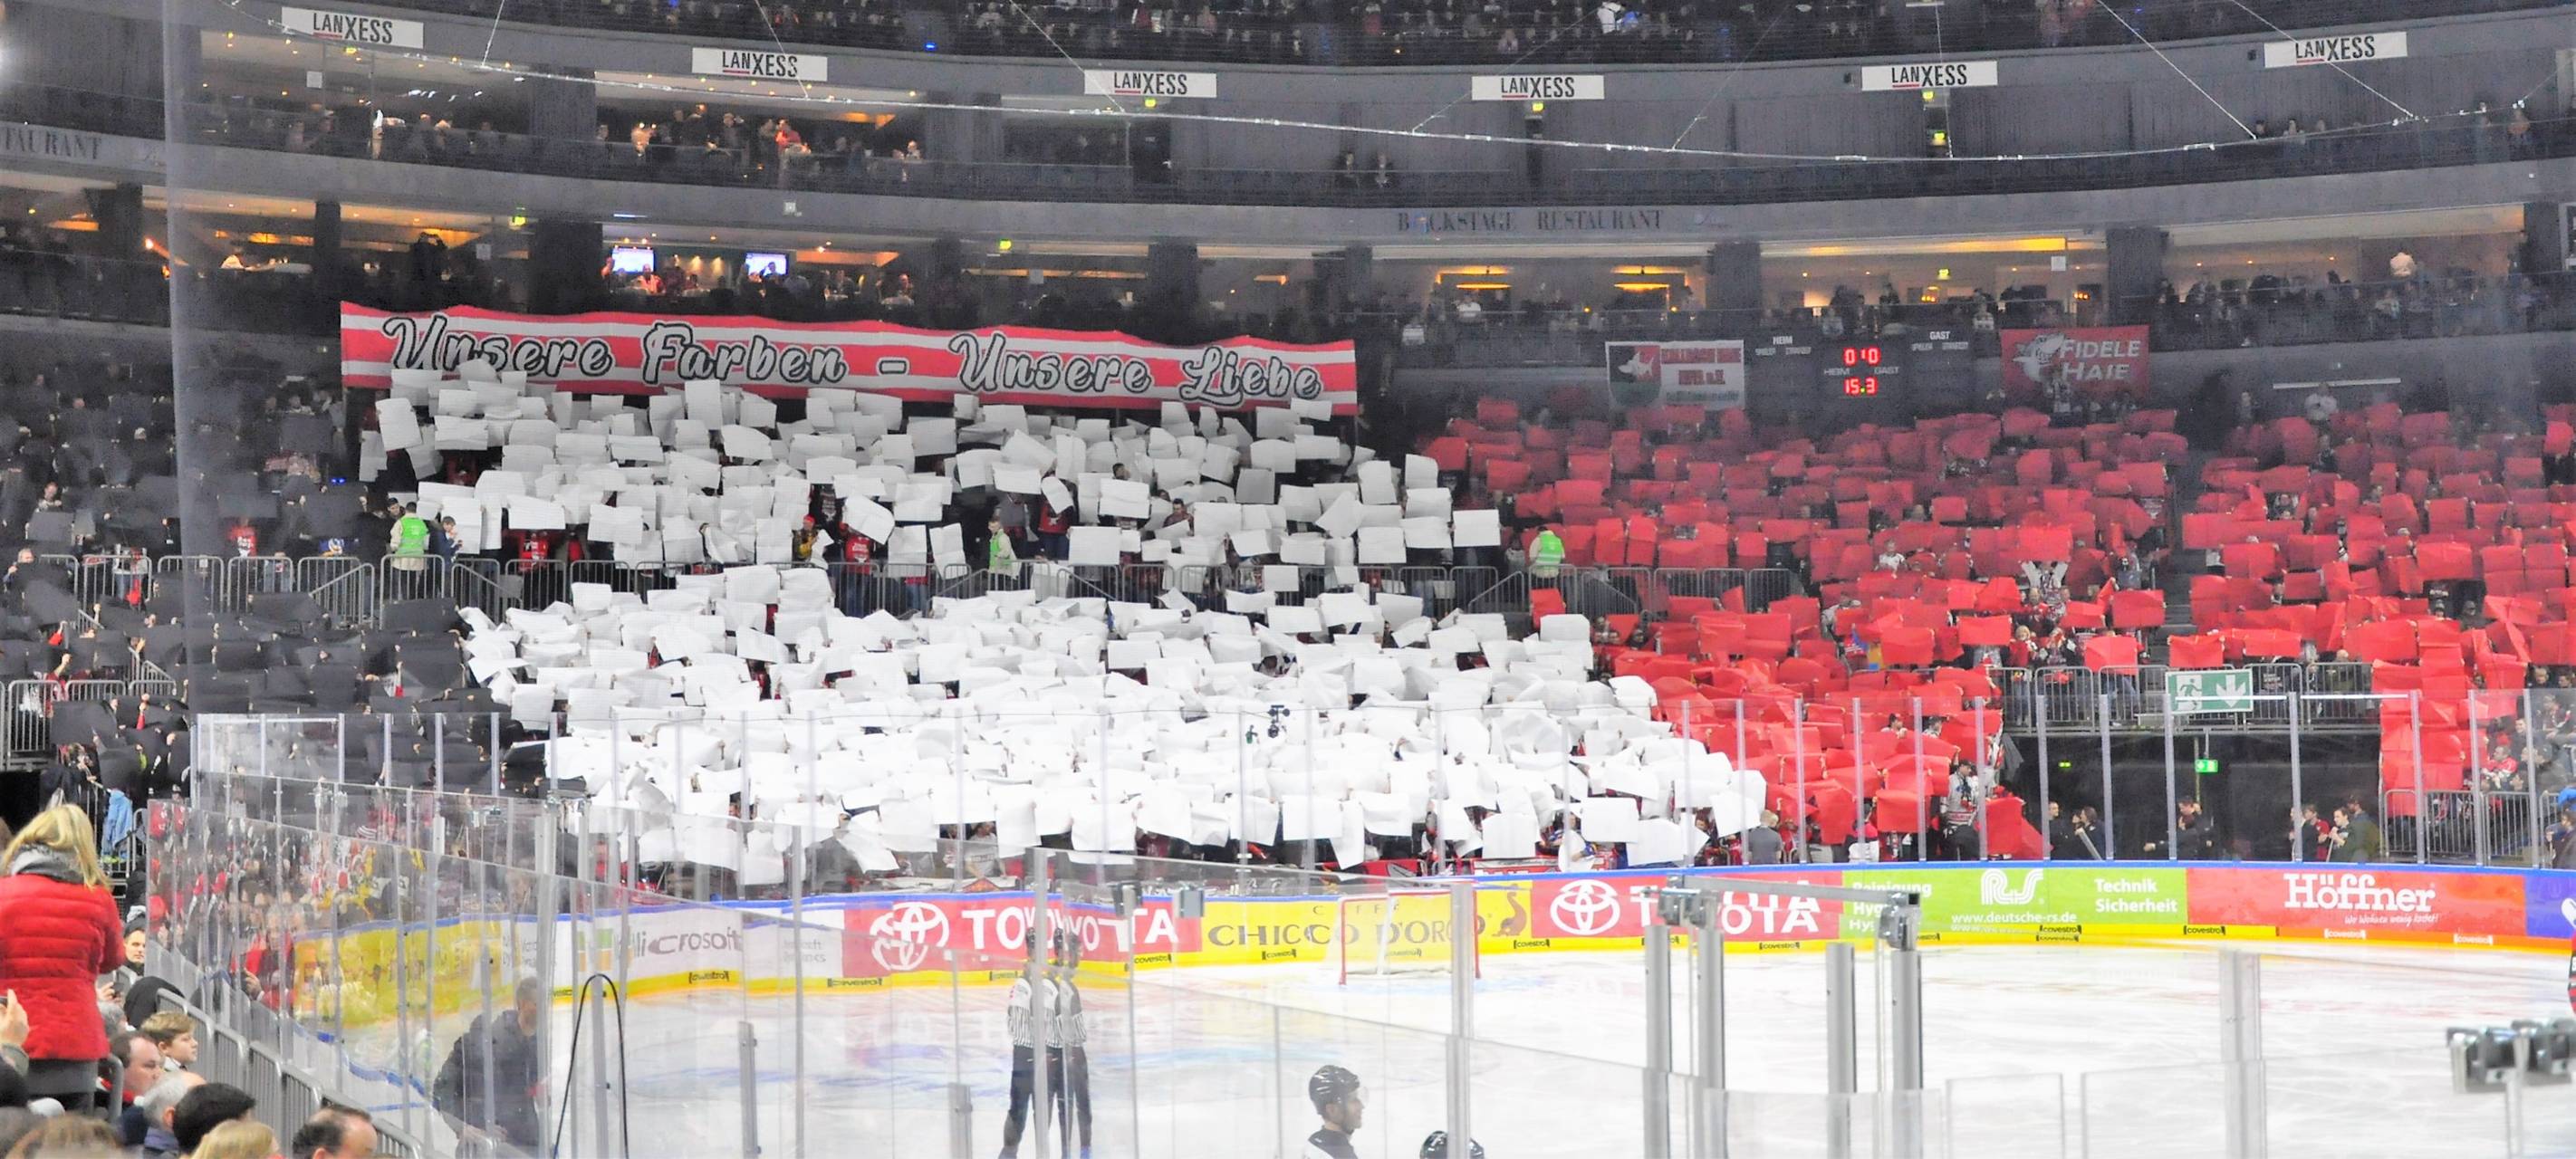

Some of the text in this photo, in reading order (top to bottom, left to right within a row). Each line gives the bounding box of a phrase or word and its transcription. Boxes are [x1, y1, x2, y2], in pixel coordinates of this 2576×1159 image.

[312, 13, 393, 44] LANXESS
[2294, 34, 2376, 62] LANXESS
[722, 51, 798, 79] LANXESS
[1890, 63, 1967, 88] LANXESS
[1113, 72, 1188, 96] LANXESS
[1500, 76, 1575, 99] LANXESS
[1536, 208, 1665, 231] RESTAURANT
[382, 313, 614, 378] Unsere
[642, 321, 848, 385] Farben
[947, 331, 1153, 394] Unsere
[1178, 346, 1322, 407] Liebe
[2059, 339, 2141, 359] FIDELE
[2062, 362, 2130, 381] HAIE
[2094, 877, 2158, 894] Technik
[2283, 873, 2437, 913] Höffner
[2095, 897, 2178, 914] Sicherheit
[1951, 912, 2078, 924] www.deutsche-rs.de
